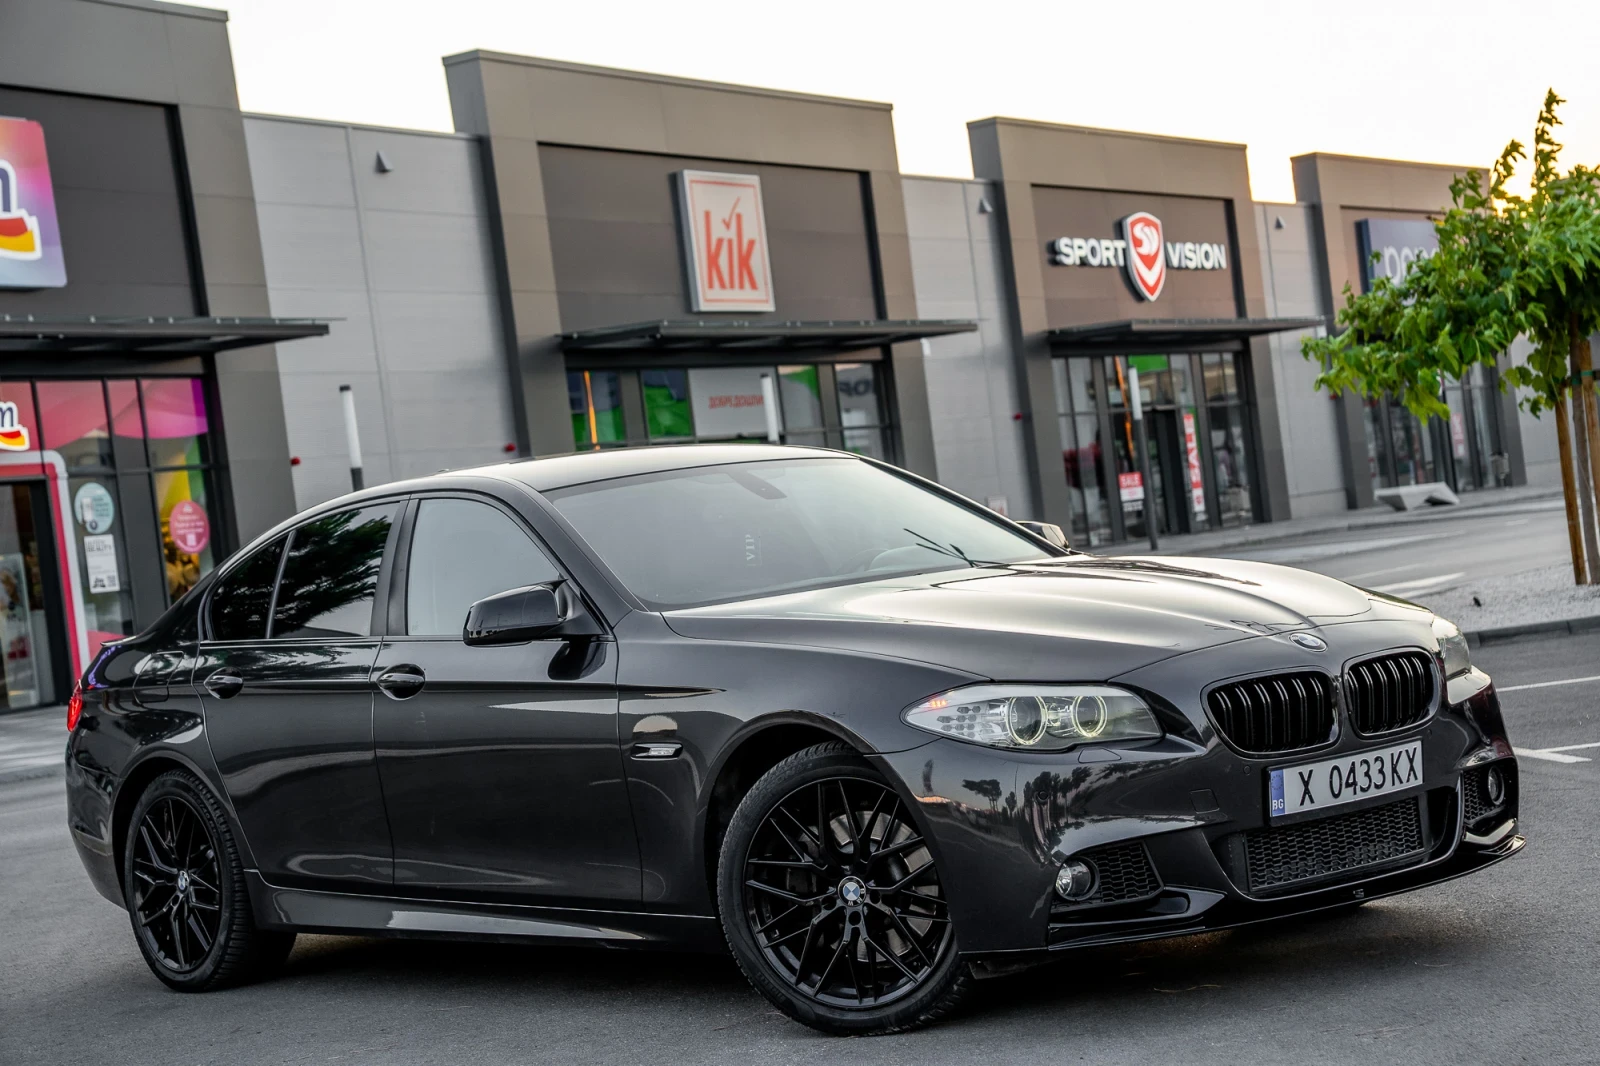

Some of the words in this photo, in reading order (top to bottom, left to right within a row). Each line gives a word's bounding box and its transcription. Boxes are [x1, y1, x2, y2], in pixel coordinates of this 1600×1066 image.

[1055, 236, 1126, 266] SPORT
[1166, 241, 1227, 269] VISION
[745, 534, 756, 561] VIP
[1272, 798, 1284, 811] BG
